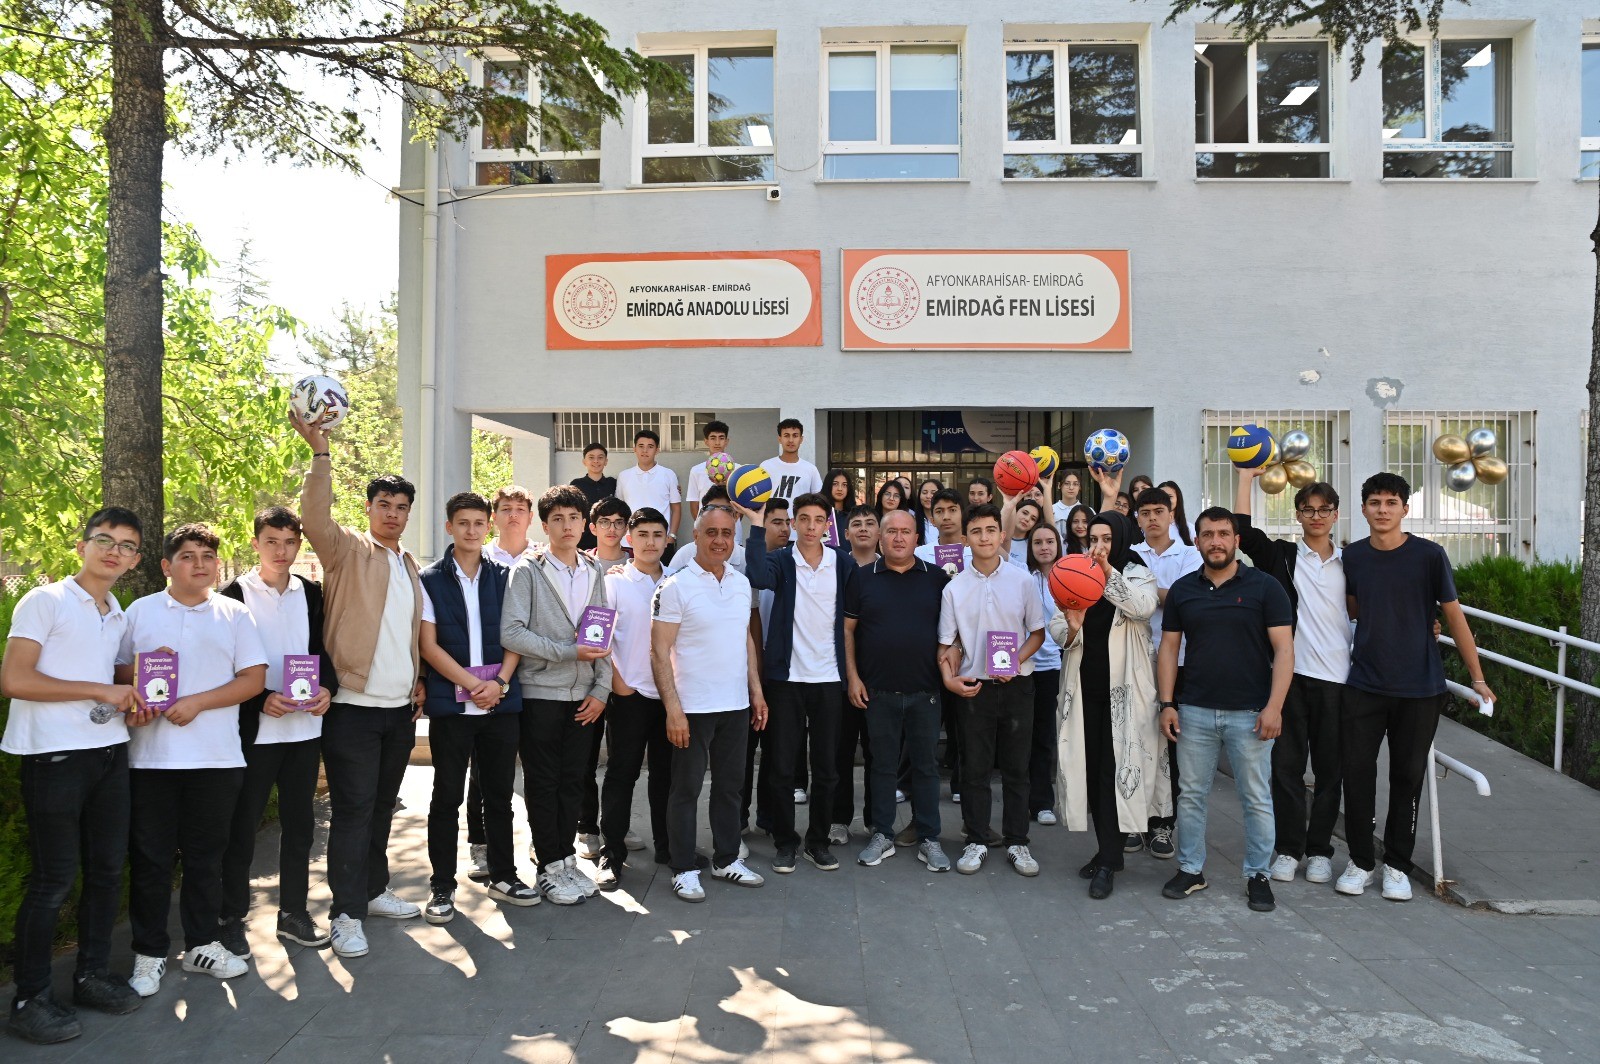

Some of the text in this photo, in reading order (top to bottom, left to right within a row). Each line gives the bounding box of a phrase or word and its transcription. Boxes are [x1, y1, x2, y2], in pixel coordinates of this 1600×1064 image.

[630, 284, 706, 293] AFYONKARAHİSAR
[713, 282, 751, 292] EMİRDAĞ
[1034, 272, 1084, 287] EMİRDAĞ
[626, 299, 684, 317] EMİRDAĞ
[687, 300, 749, 316] ANADOLU
[752, 297, 789, 316] LİSESİ
[926, 295, 1095, 317] EMİRDAĞ FEN LİSESİ
